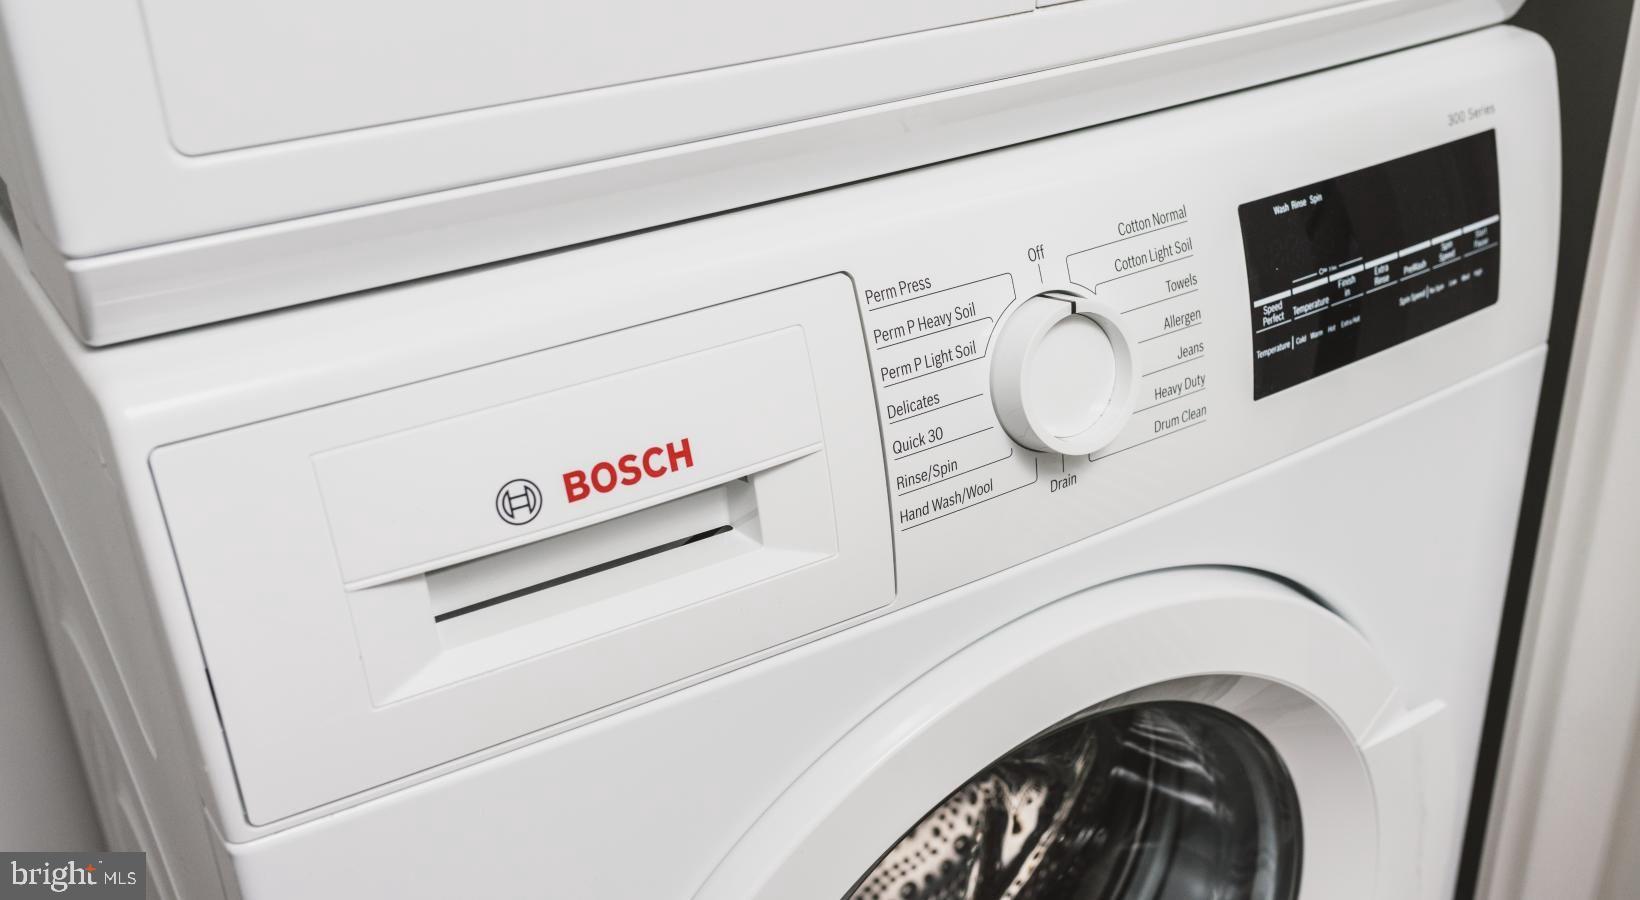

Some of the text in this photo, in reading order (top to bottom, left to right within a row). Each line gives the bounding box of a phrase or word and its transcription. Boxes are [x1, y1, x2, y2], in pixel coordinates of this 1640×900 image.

[1467, 104, 1496, 121] Series
[1272, 193, 1323, 216] Wash Rinse Spin
[1117, 204, 1188, 236] Cotton Normal
[1027, 244, 1045, 262] Off
[1114, 237, 1193, 272] Cotton Light Soil
[864, 277, 932, 305] Perm Press
[1165, 273, 1198, 293] Towels
[1337, 275, 1357, 289] Finish
[1343, 288, 1352, 298] in
[1163, 309, 1202, 330] Allergen
[1262, 299, 1284, 316] Speed
[1262, 311, 1286, 327] Perfect
[1292, 296, 1330, 316] Temperature
[873, 301, 976, 344] Perm P Heavy Soil
[1177, 342, 1205, 360] Jeans
[1256, 341, 1291, 359] Temperature
[1295, 334, 1308, 345] Cold
[1310, 329, 1324, 340] Warm
[880, 340, 977, 382] Perm P Light Soil
[1154, 374, 1206, 401] Heavy Duty
[886, 393, 941, 420] Delicates
[1154, 406, 1207, 434] Drum Clean
[892, 426, 944, 454] Quick 30
[562, 437, 694, 503] BOSCH
[896, 460, 958, 490] Rinse/Spin
[1050, 474, 1077, 493] Drain
[900, 478, 994, 524] Hand Wash/Wool
